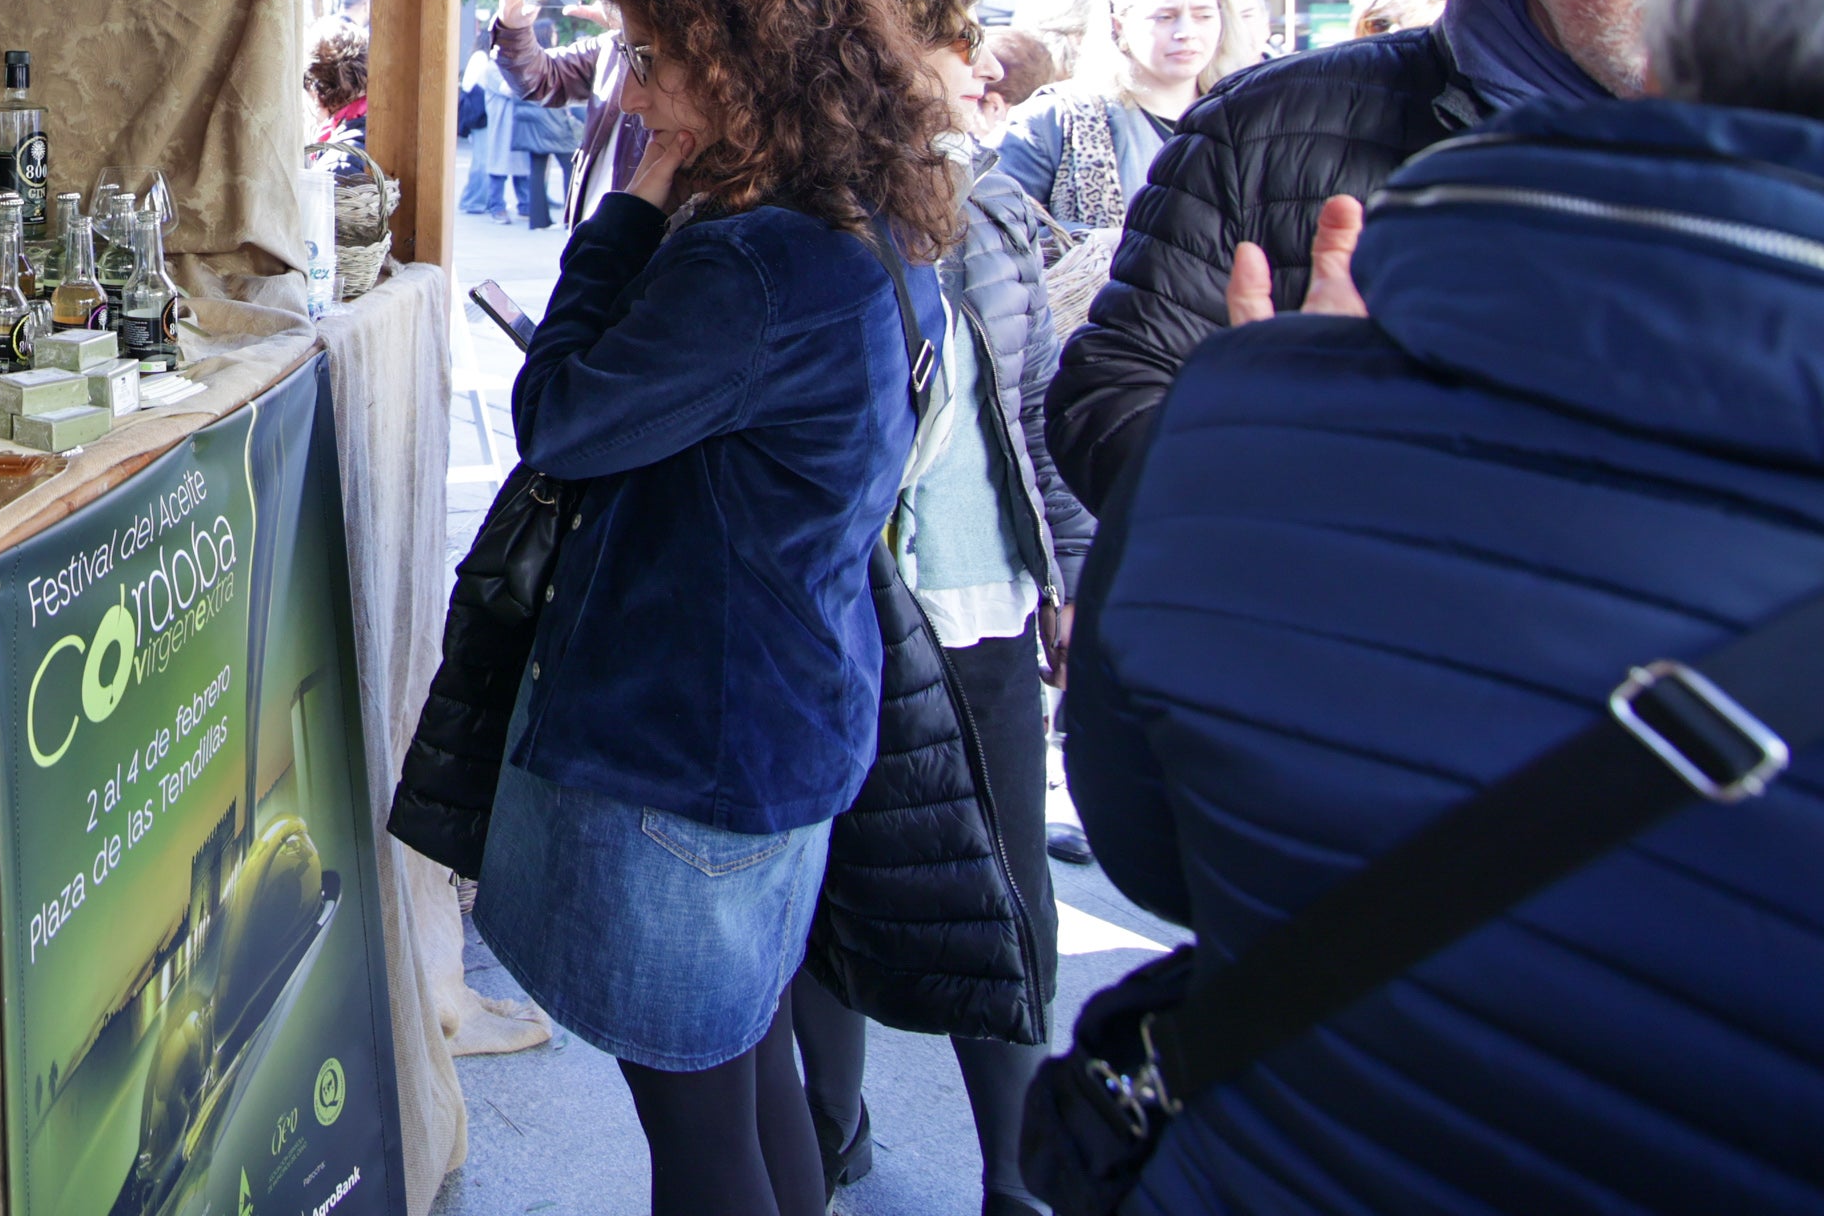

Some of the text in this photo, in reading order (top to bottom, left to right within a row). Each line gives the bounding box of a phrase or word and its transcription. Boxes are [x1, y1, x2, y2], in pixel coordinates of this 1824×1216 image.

[25, 164, 48, 179] 800
[27, 187, 46, 199] GIN
[27, 469, 208, 629] Festival del Aceite
[27, 515, 237, 769] Córdoba
[133, 570, 236, 686] virgenextra
[86, 664, 231, 833] 2 al 4 de febrero
[30, 715, 229, 965] Plaza de las Tendillas
[311, 1165, 362, 1216] AgroBank
